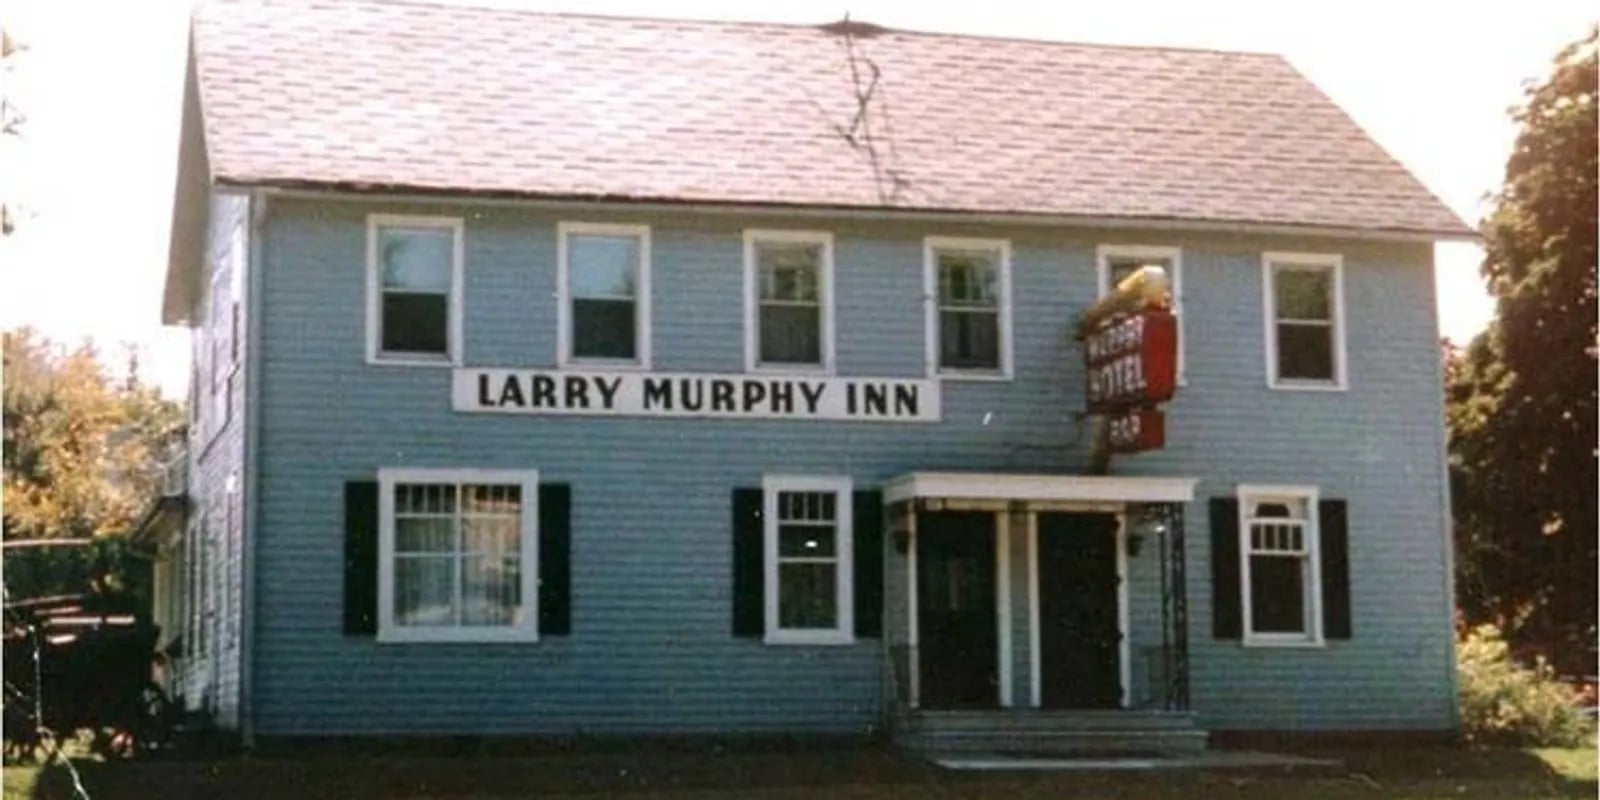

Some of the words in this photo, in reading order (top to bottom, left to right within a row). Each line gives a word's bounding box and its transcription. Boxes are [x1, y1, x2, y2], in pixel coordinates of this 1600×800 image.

[478, 373, 623, 410] LARRY
[642, 377, 827, 413] MURPHY
[845, 383, 919, 416] INN
